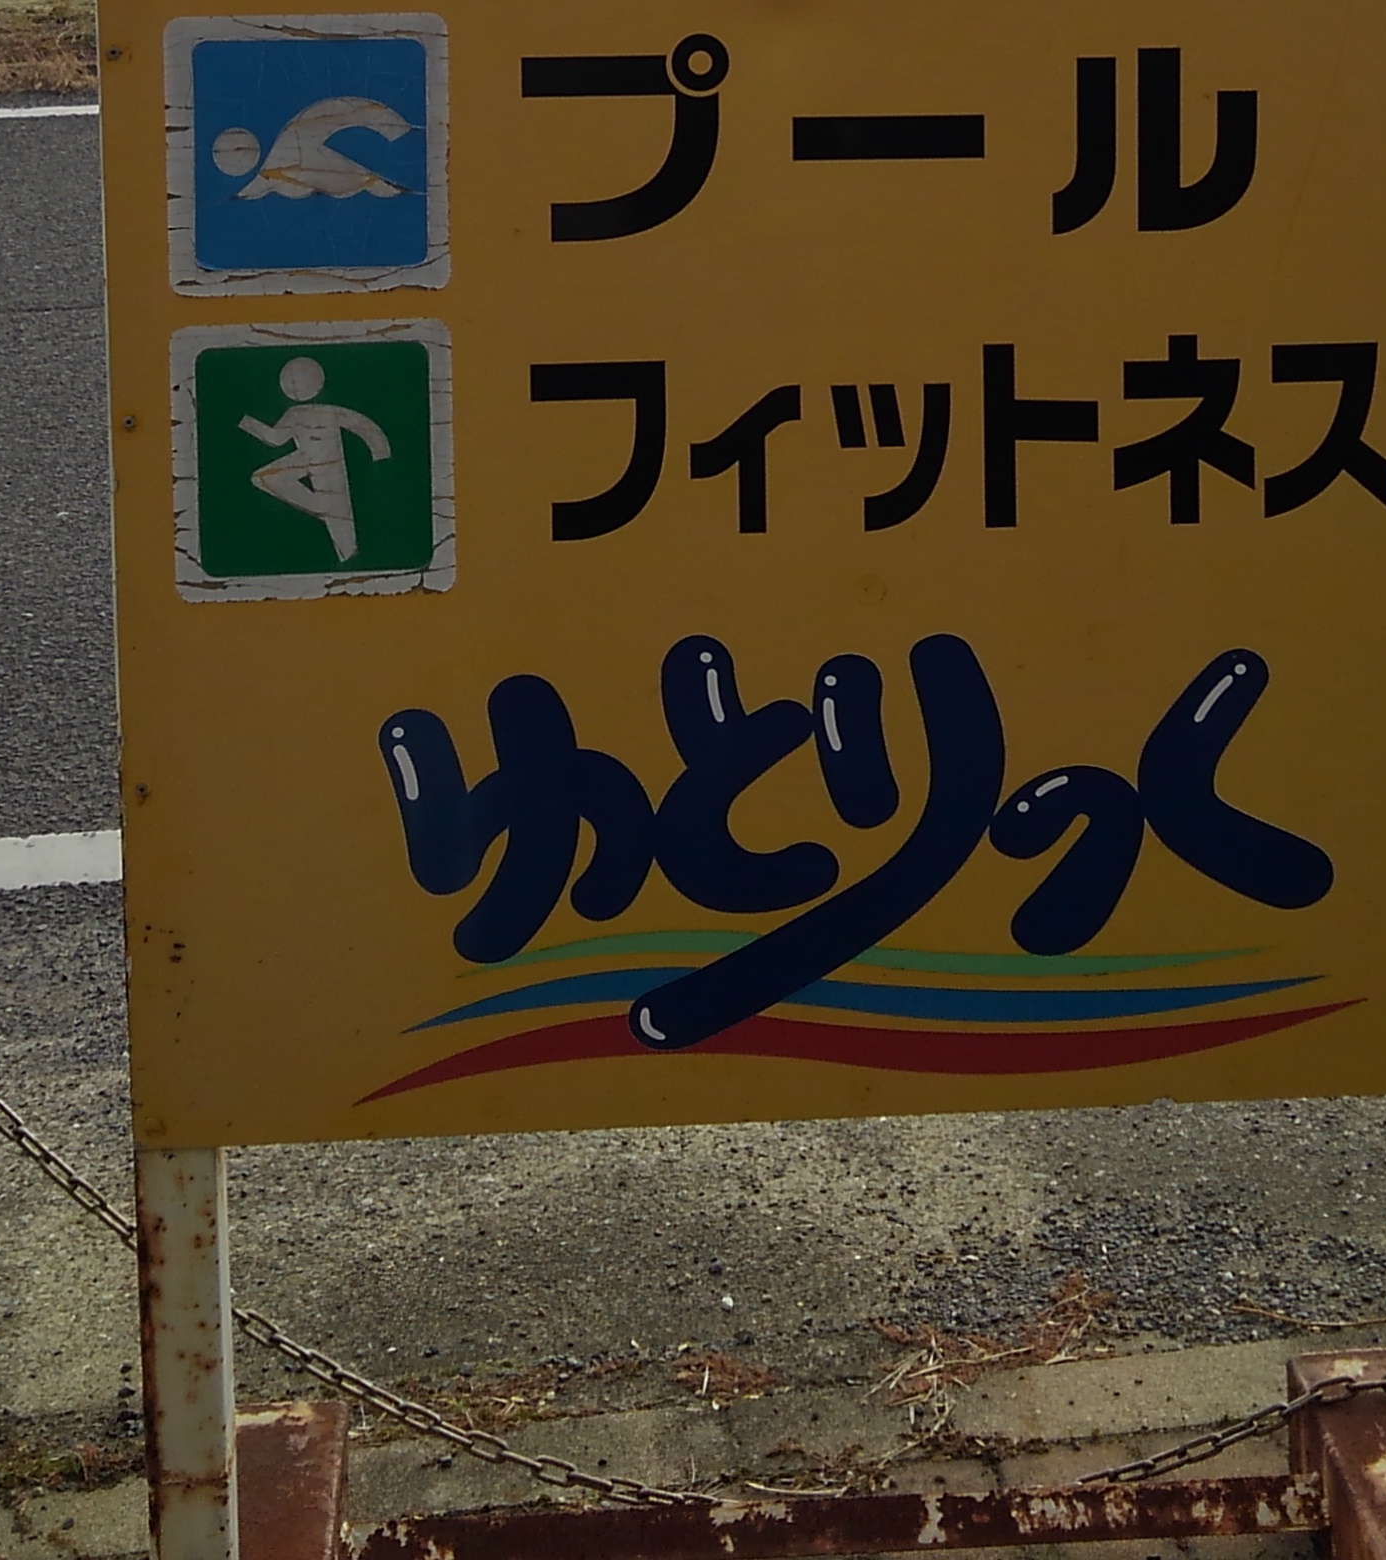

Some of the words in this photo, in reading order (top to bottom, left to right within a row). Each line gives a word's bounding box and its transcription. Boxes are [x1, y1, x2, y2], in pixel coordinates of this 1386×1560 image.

[521, 34, 1258, 243] プール
[378, 633, 1335, 1053] ゆとりっく
